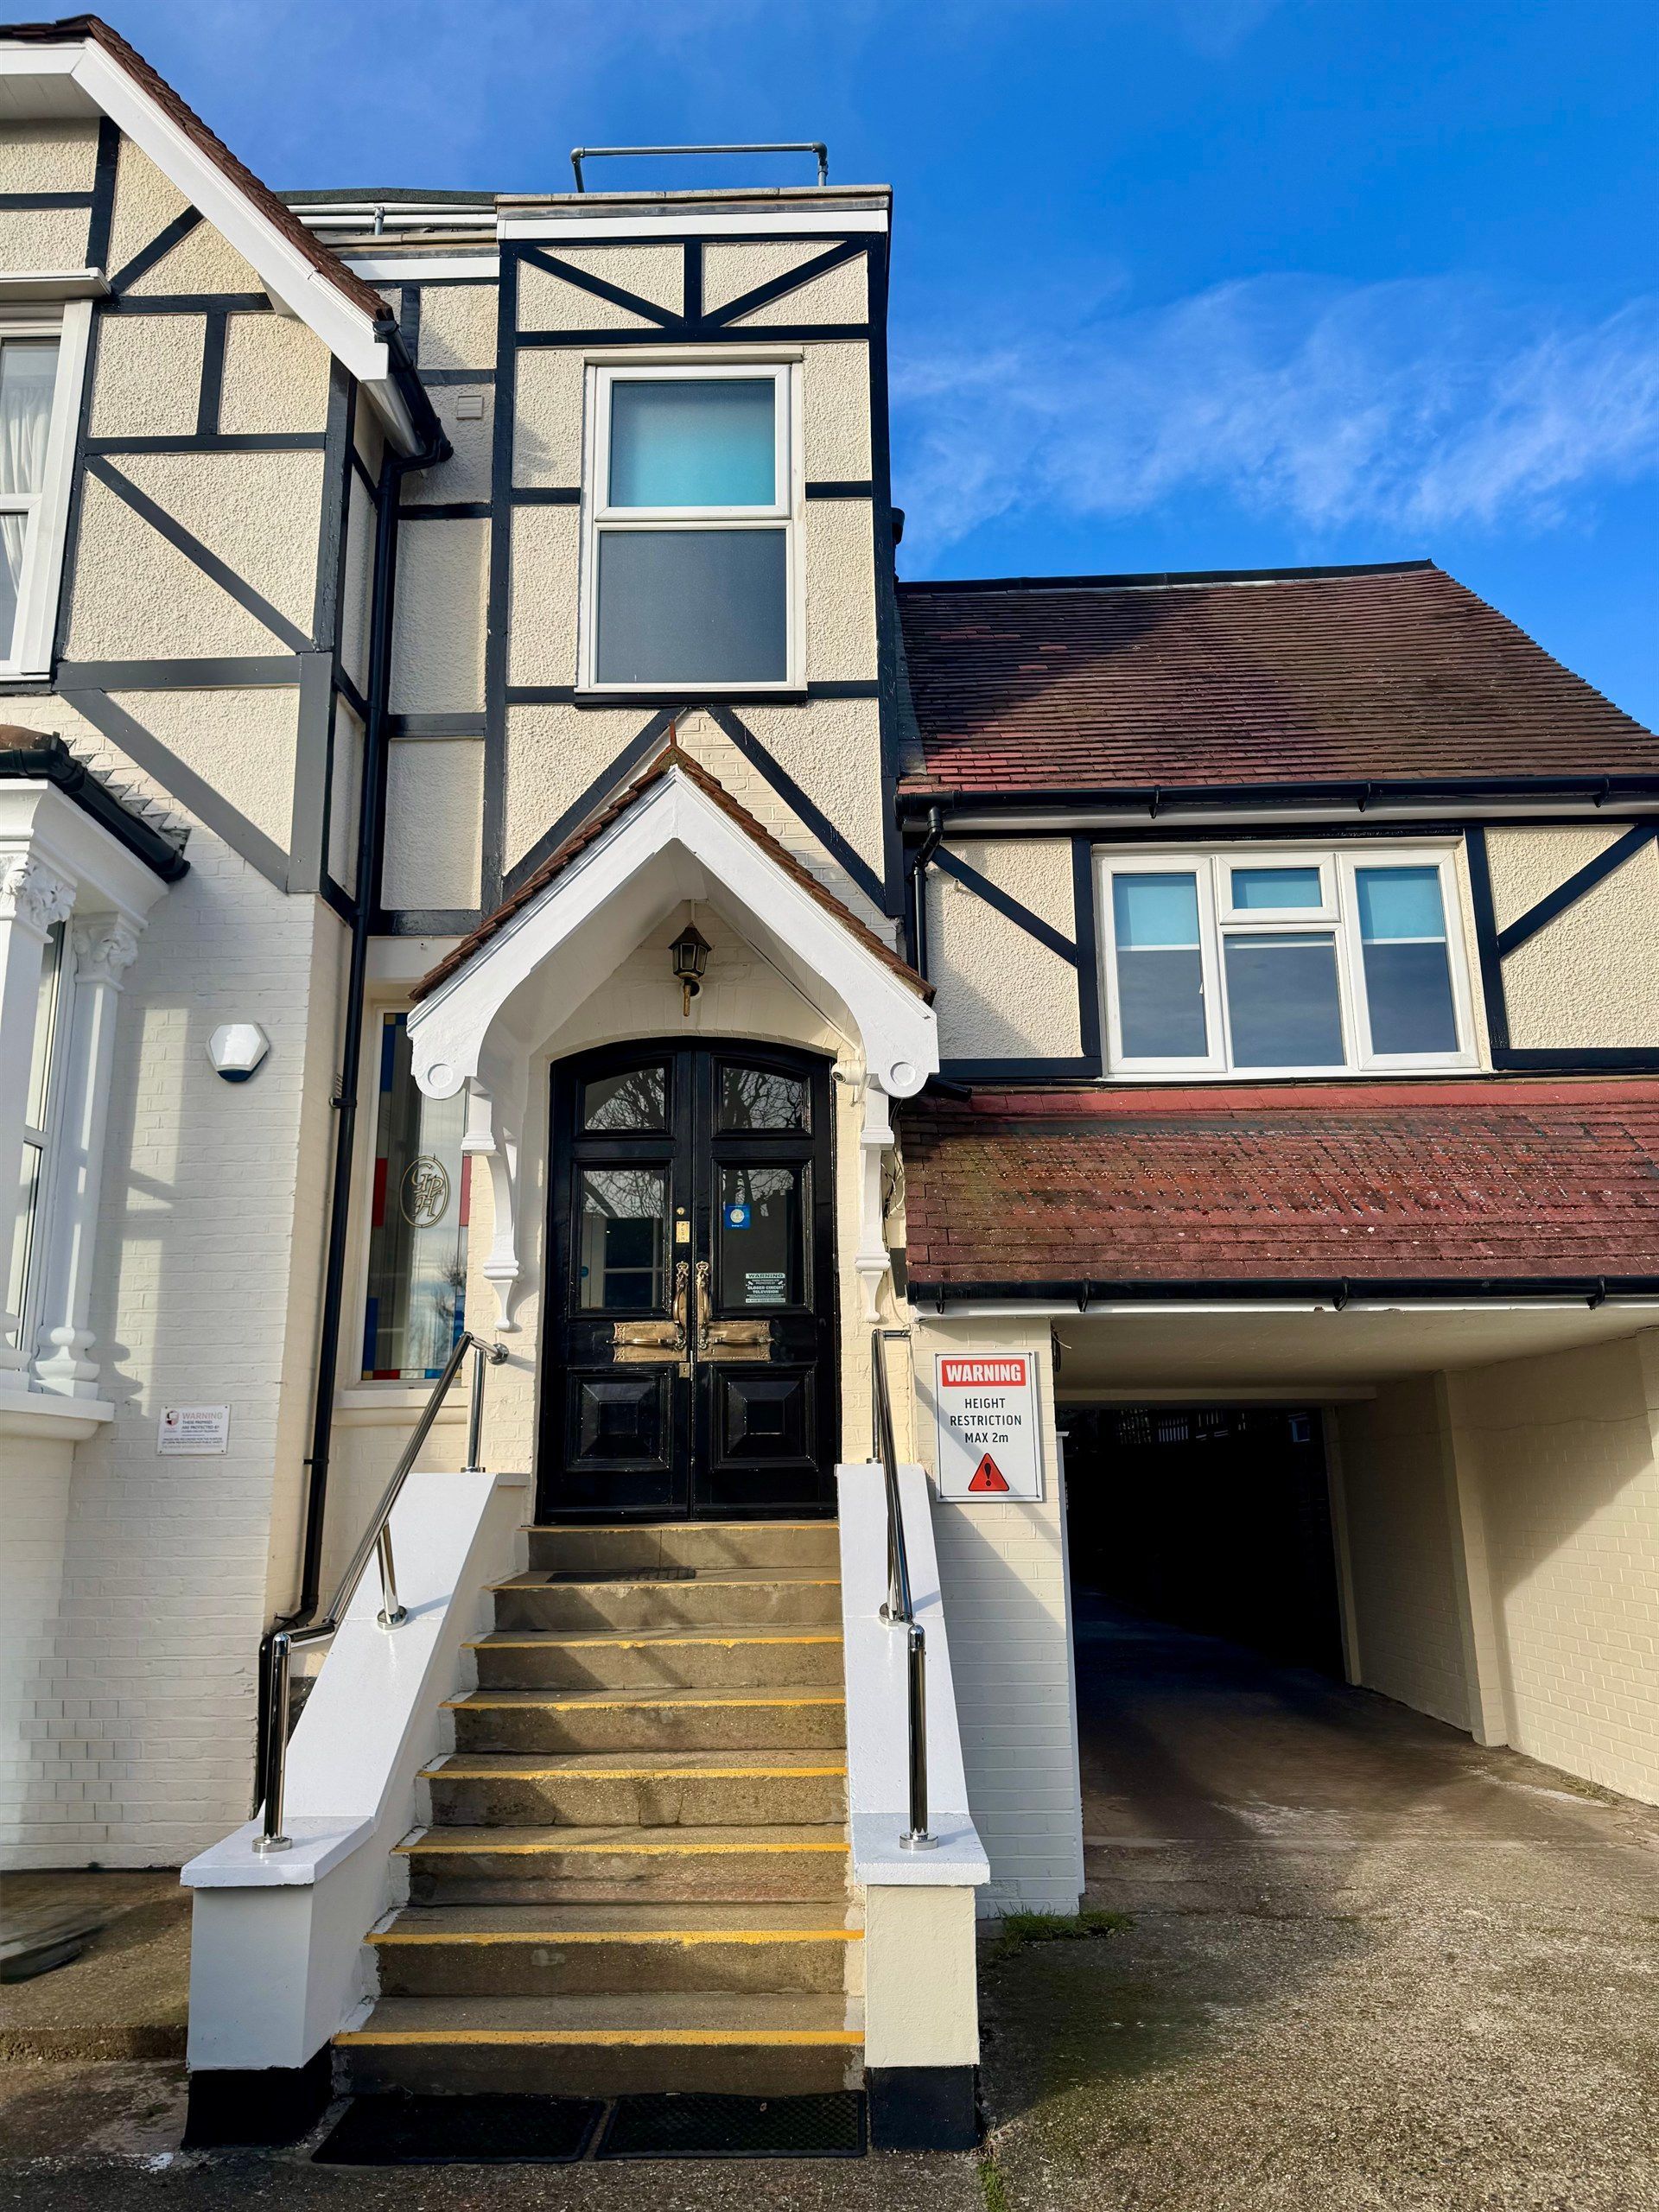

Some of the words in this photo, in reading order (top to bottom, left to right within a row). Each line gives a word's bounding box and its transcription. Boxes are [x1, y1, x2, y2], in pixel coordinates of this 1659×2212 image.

[946, 1364, 1021, 1382] WARNING
[964, 1397, 1006, 1409] HEIGHT
[950, 1414, 1021, 1427] RESTRICTION
[964, 1432, 988, 1443] MAX
[992, 1433, 1008, 1443] 2m
